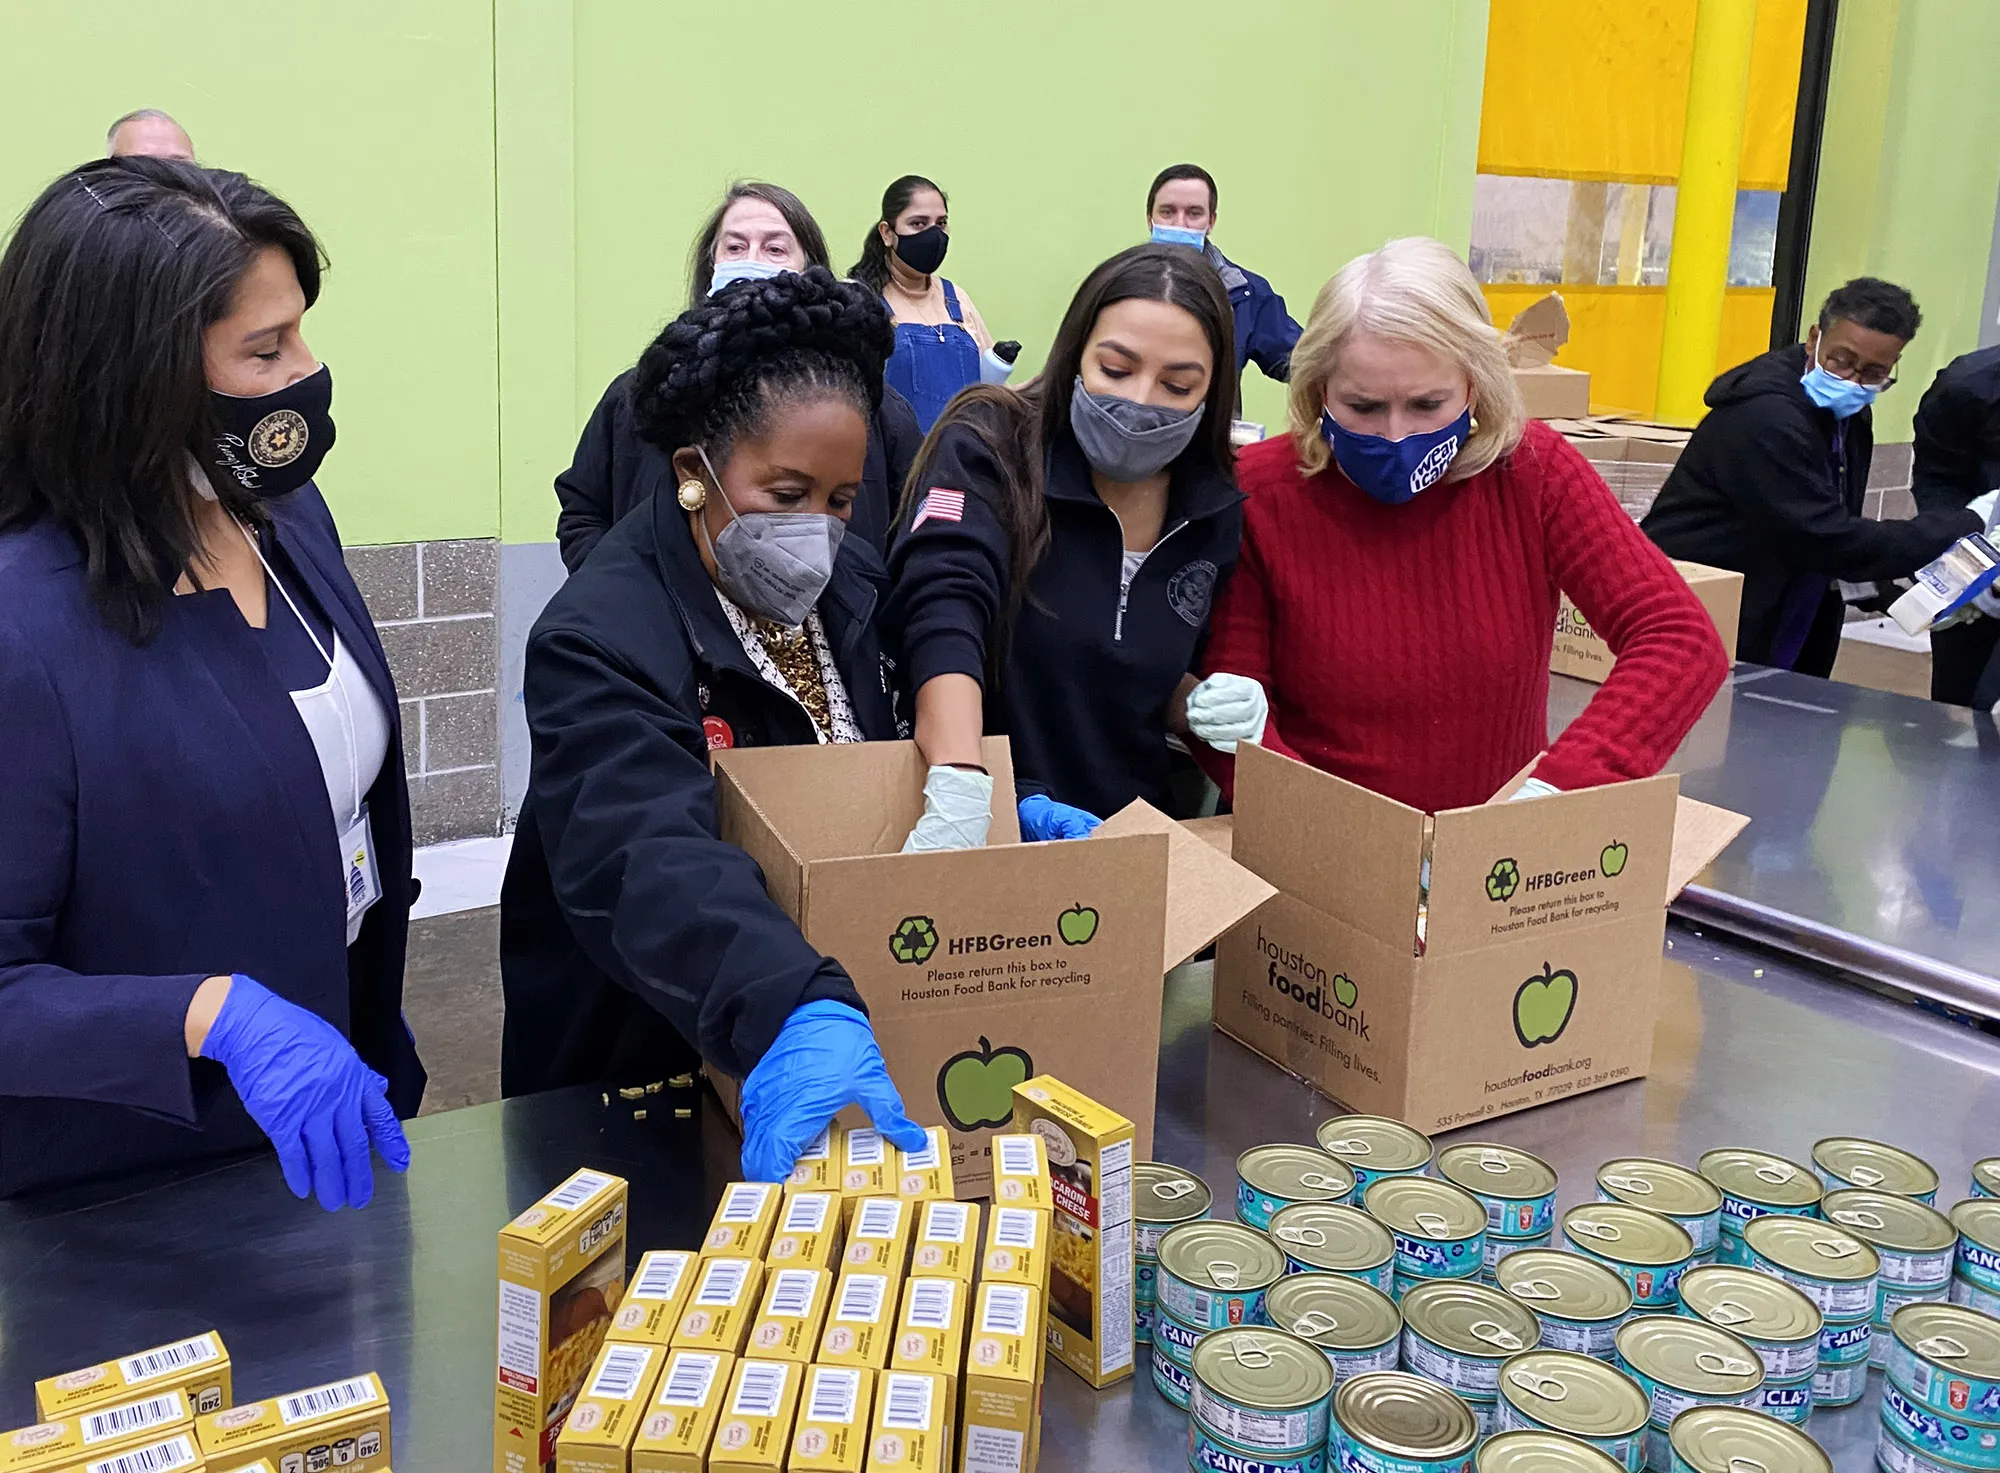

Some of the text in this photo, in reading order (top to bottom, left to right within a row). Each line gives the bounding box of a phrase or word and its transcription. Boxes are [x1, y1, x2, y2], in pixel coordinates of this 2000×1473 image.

[1417, 438, 1456, 476] wear
[1525, 869, 1596, 892] HFBGreen
[1491, 901, 1619, 935] Houston Food Bank for recycling
[1509, 890, 1604, 917] Please return this box to
[949, 934, 1052, 955] HFBGreen
[1257, 925, 1327, 987] houston
[927, 958, 1067, 982] Please return this box to
[901, 972, 1091, 1001] Houston Food Bank for recycling
[1268, 962, 1370, 1041] foodbank
[1242, 990, 1382, 1084] Filling pantries. Filling lives.
[1484, 1057, 1592, 1094] houstonfoodbank.org
[1436, 1114, 1454, 1128] 535
[1057, 1194, 1091, 1221] CHEESE
